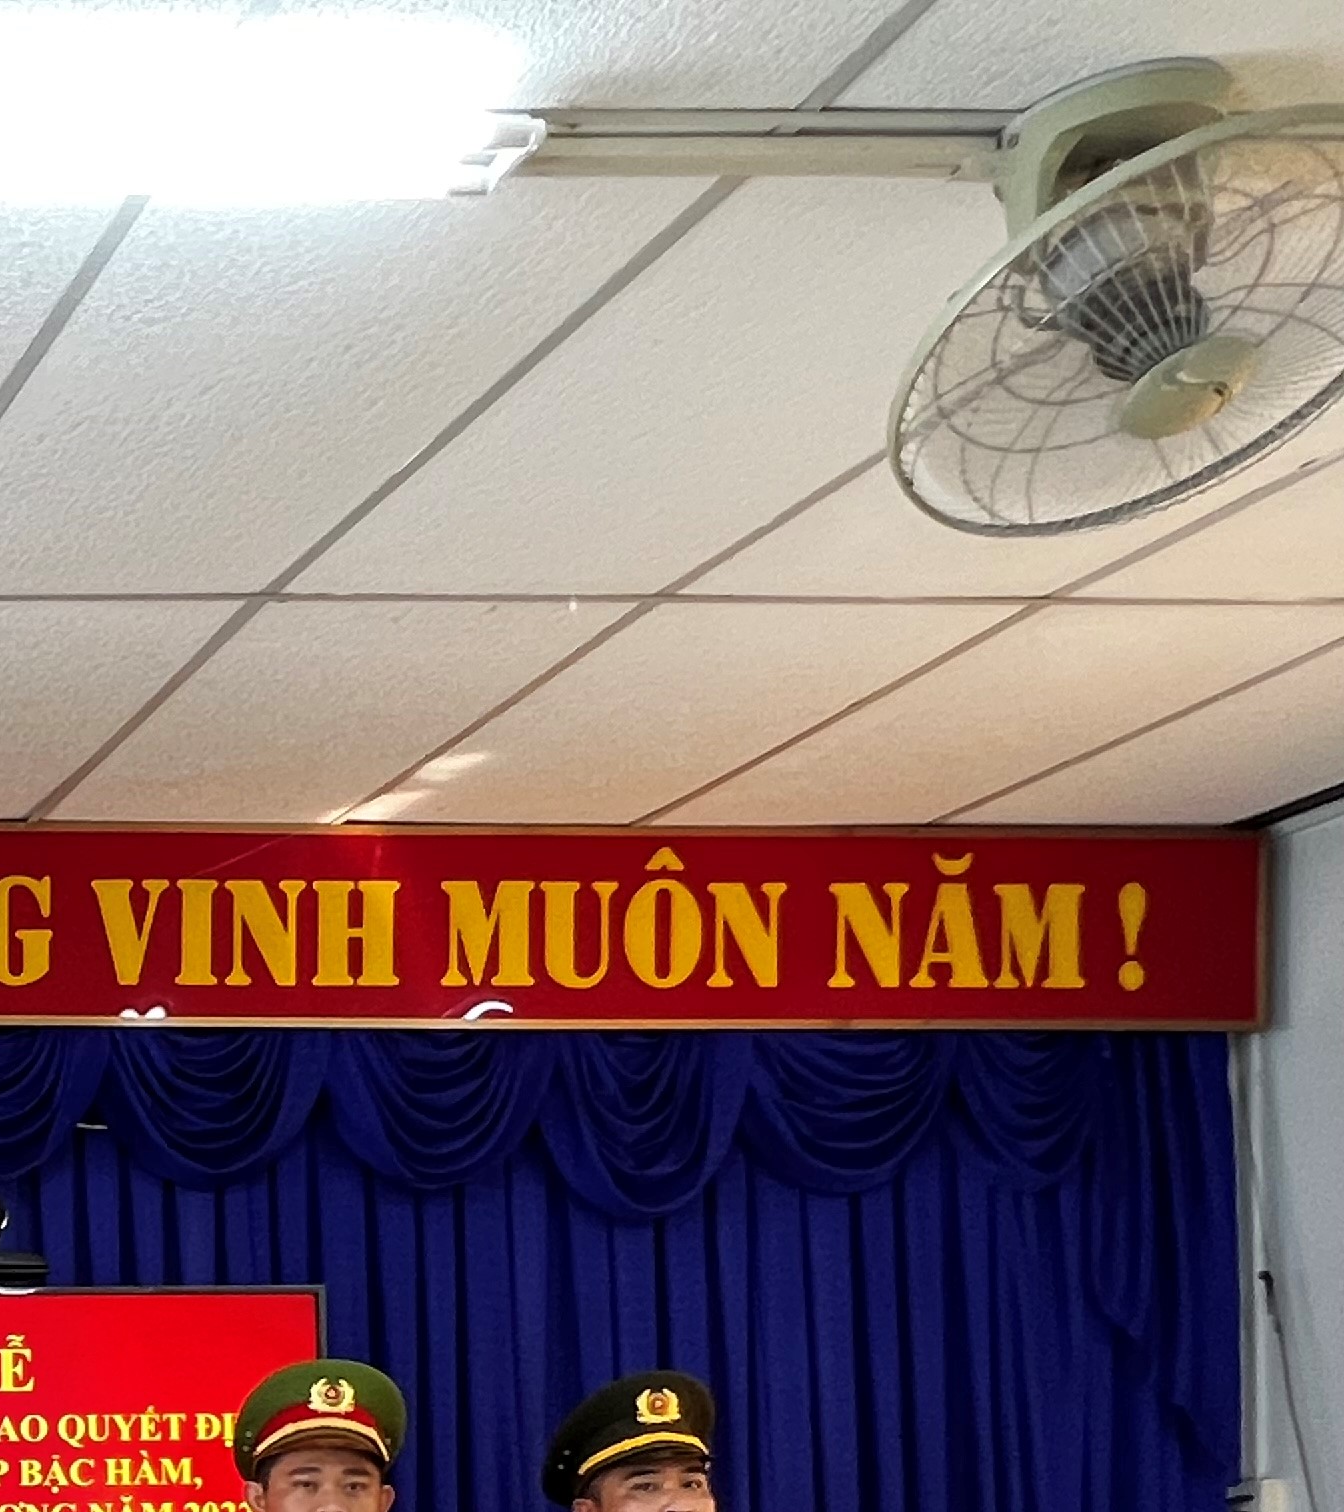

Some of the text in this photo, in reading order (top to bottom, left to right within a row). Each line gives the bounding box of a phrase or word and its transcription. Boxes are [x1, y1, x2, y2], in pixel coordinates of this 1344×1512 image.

[91, 879, 401, 987] VINH
[440, 847, 788, 988] MUÔN
[827, 853, 1086, 989] NĂM
[1118, 882, 1146, 991] !
[57, 1405, 187, 1448] QUYẾT
[195, 1412, 240, 1448] ĐỊ
[19, 1454, 96, 1494] BẬC
[104, 1450, 204, 1490] HÀM,
